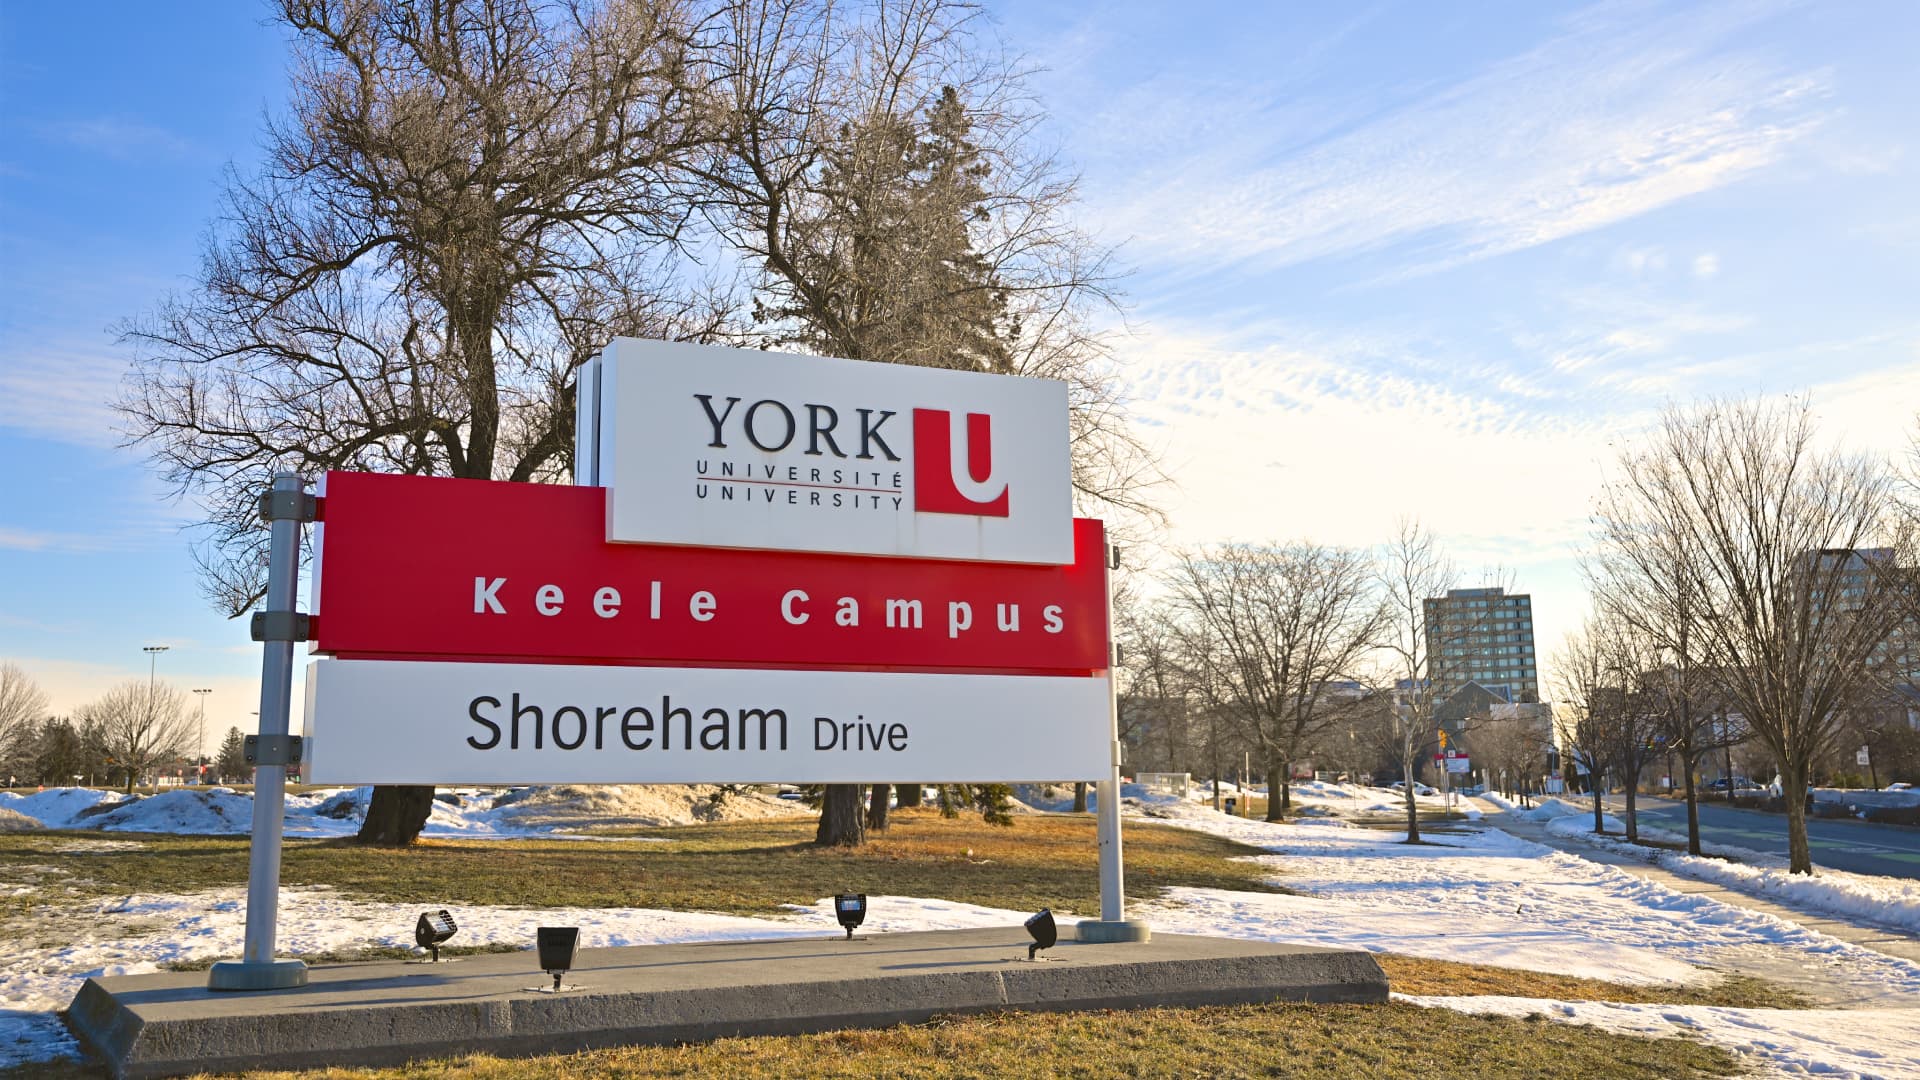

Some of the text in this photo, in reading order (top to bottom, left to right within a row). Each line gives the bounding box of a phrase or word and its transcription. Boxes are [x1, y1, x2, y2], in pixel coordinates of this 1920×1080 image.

[693, 393, 902, 463] YORK
[696, 459, 903, 488] UNIVERSITÉ
[696, 484, 903, 512] UNIVERSITY
[473, 576, 1065, 639] Keele Campus
[466, 692, 909, 752] Shoreham Drive
